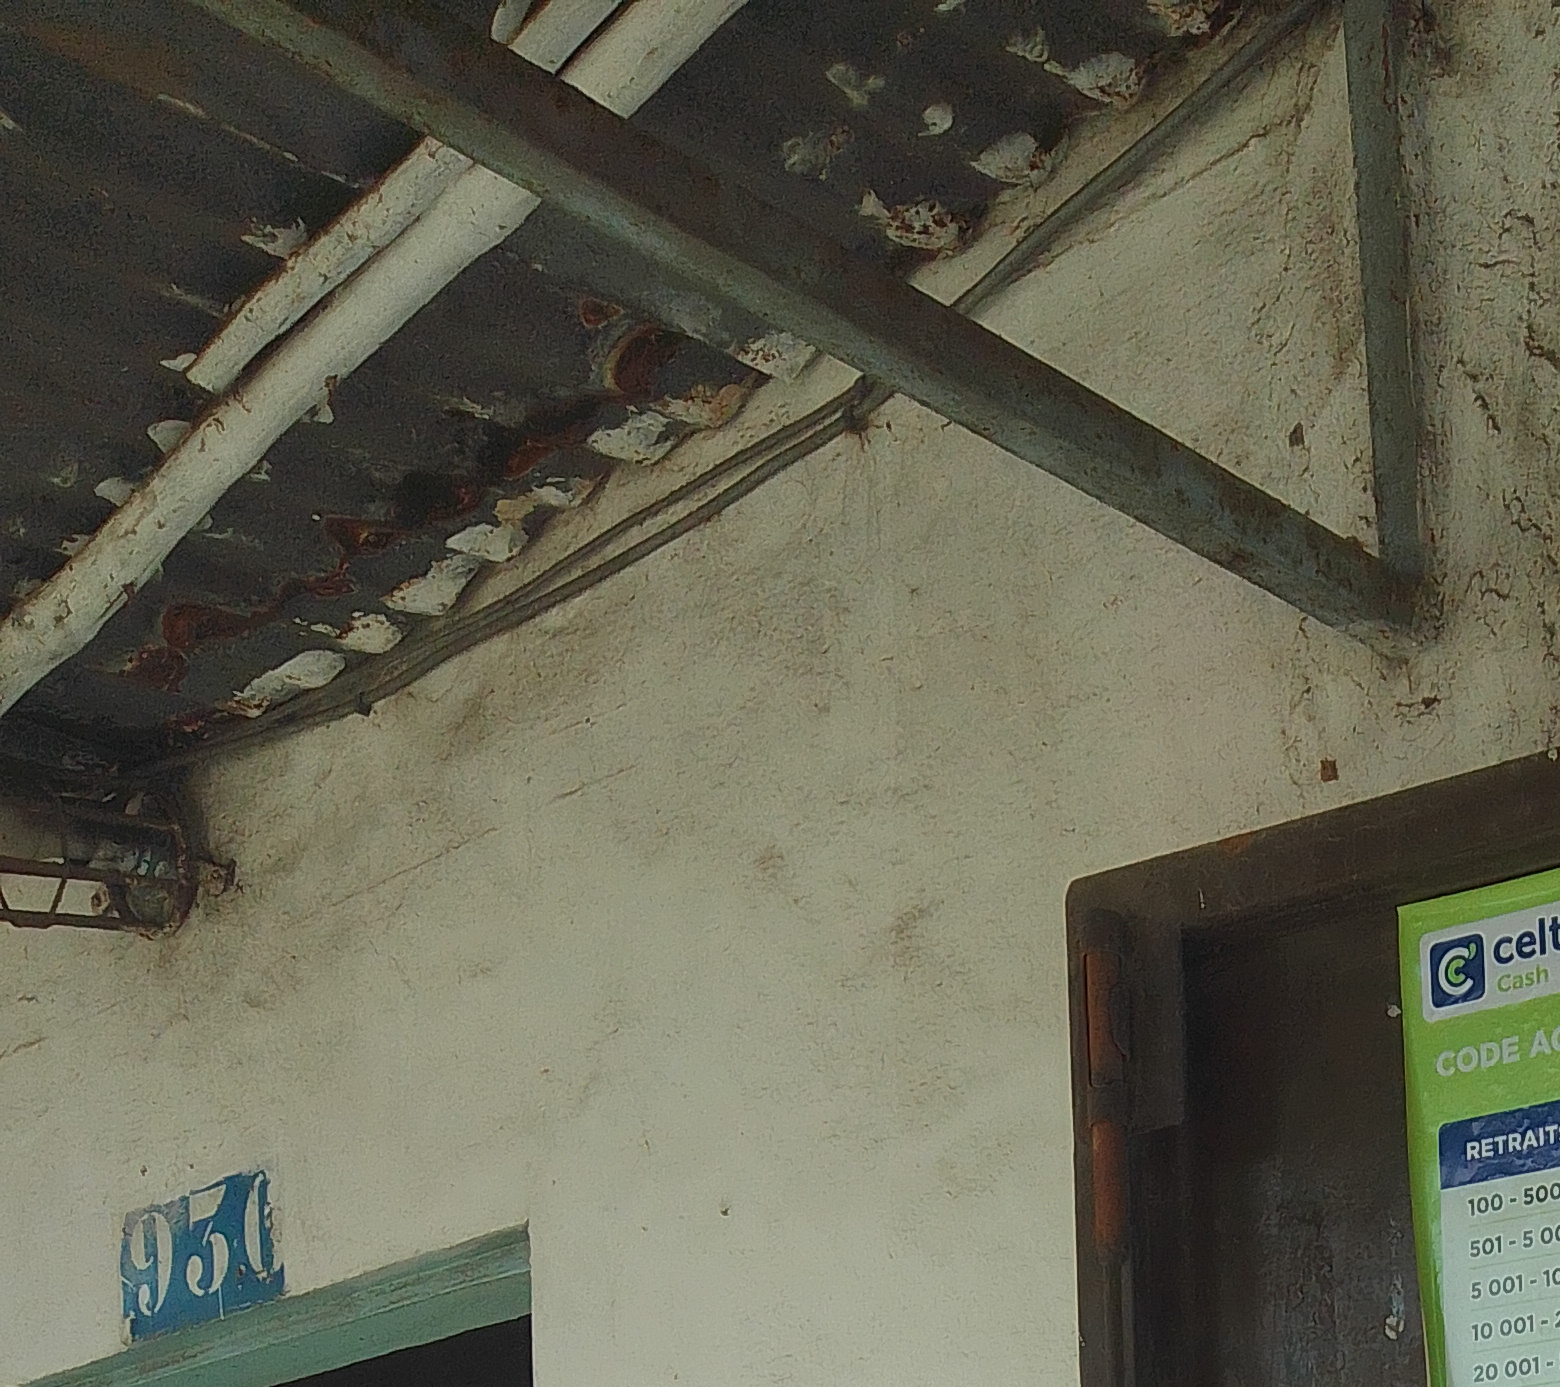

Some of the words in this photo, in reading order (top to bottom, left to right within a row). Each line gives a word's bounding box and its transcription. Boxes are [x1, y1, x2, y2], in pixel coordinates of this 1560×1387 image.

[1497, 966, 1549, 993] Cash
[1436, 1036, 1520, 1077] CODE
[1468, 1195, 1503, 1216] 100
[1469, 1236, 1502, 1258] 501
